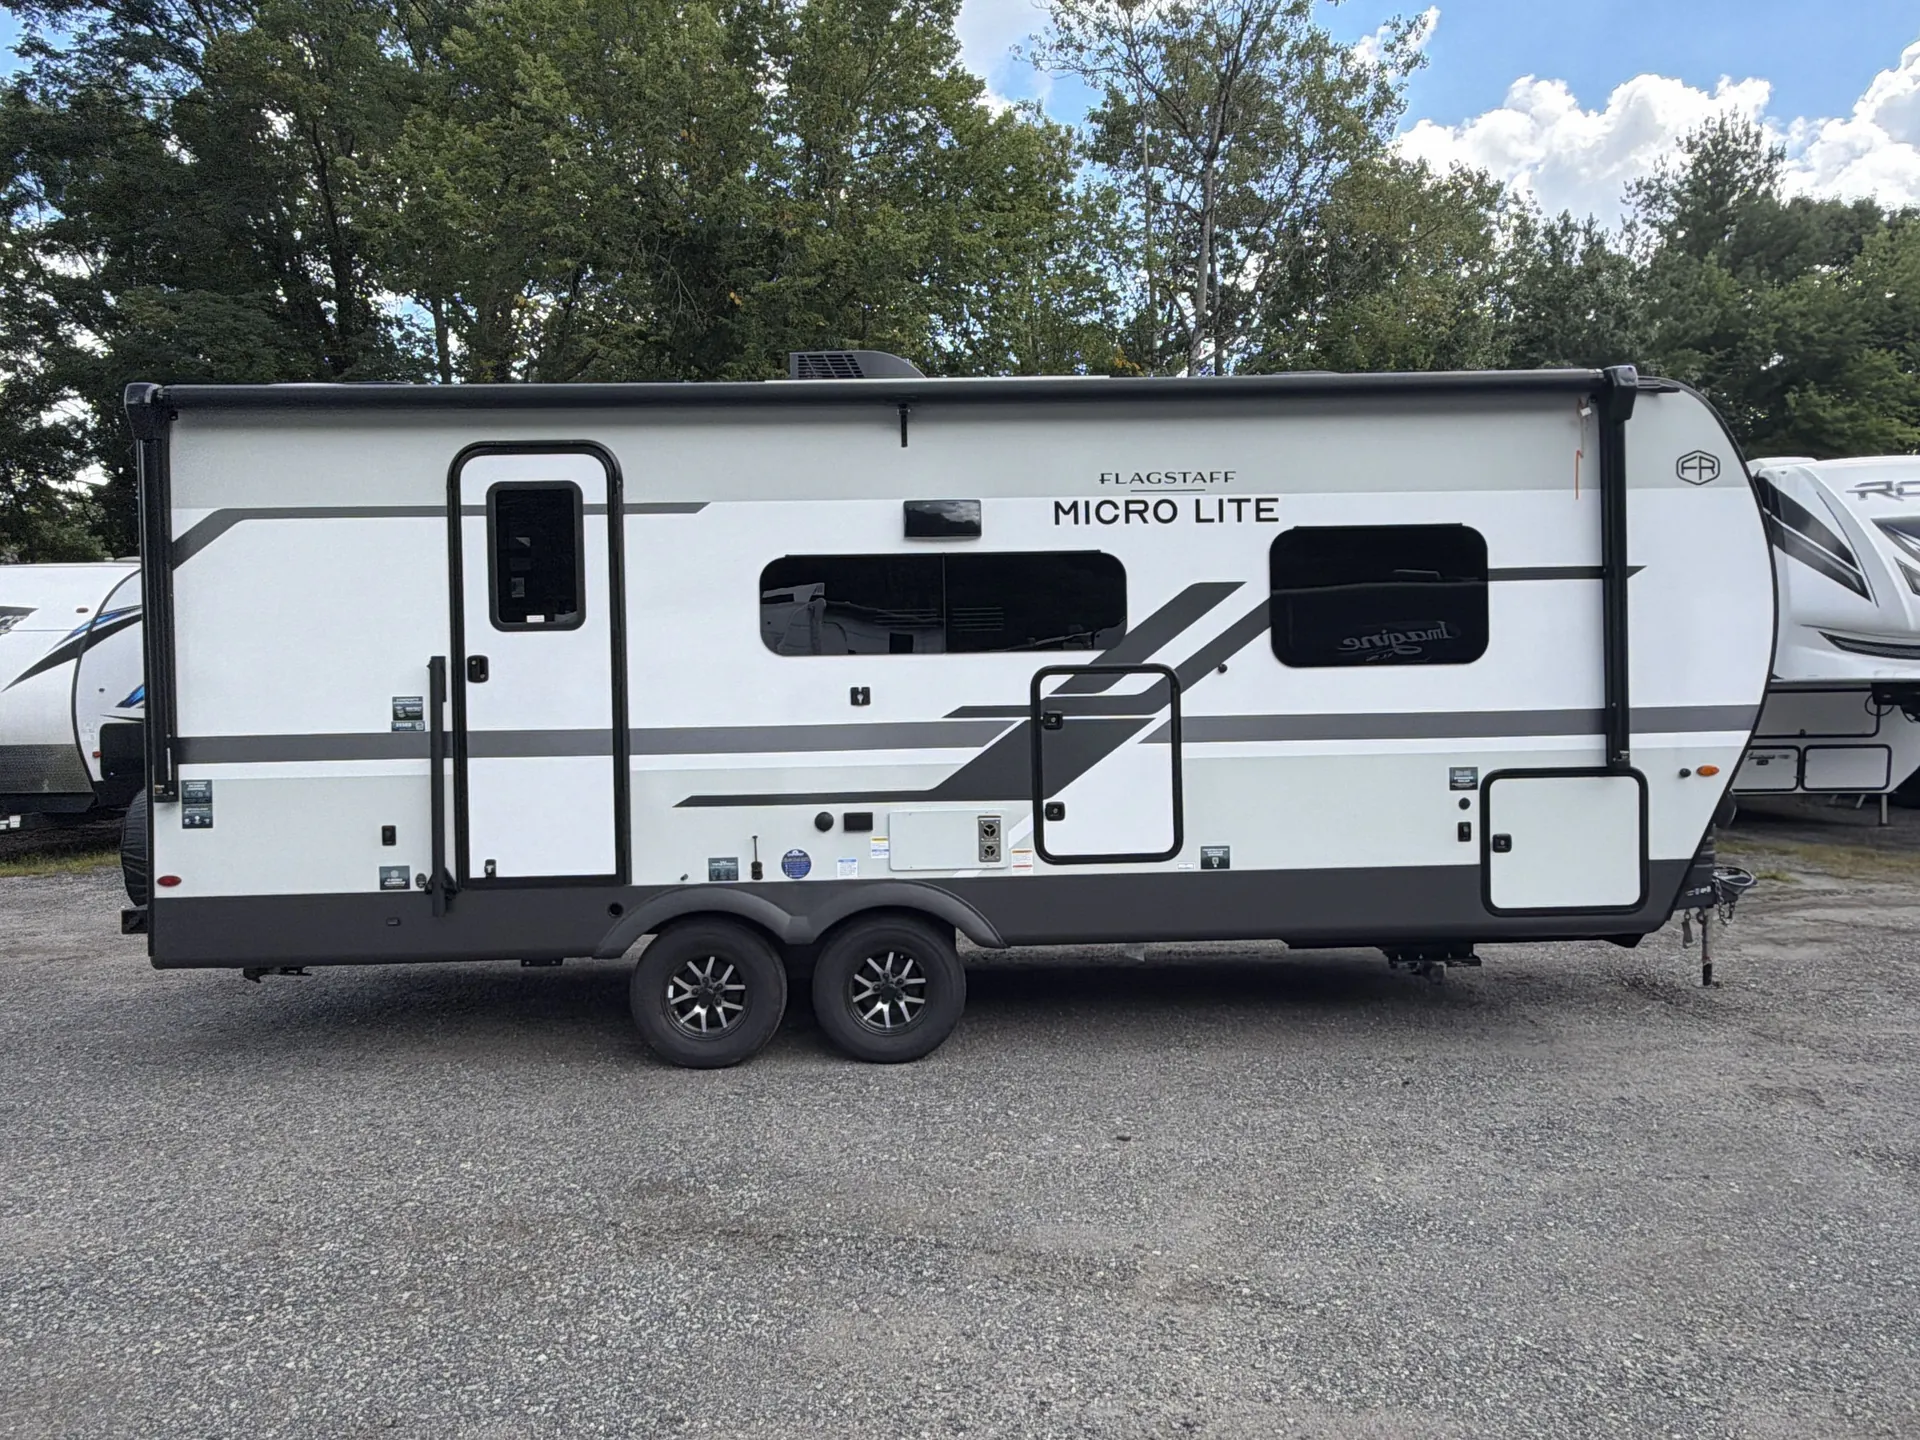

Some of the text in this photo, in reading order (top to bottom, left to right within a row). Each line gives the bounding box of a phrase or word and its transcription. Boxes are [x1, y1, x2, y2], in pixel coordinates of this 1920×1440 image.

[1099, 471, 1236, 485] FLAGSTAFF
[1054, 498, 1280, 525] MICRO LITE
